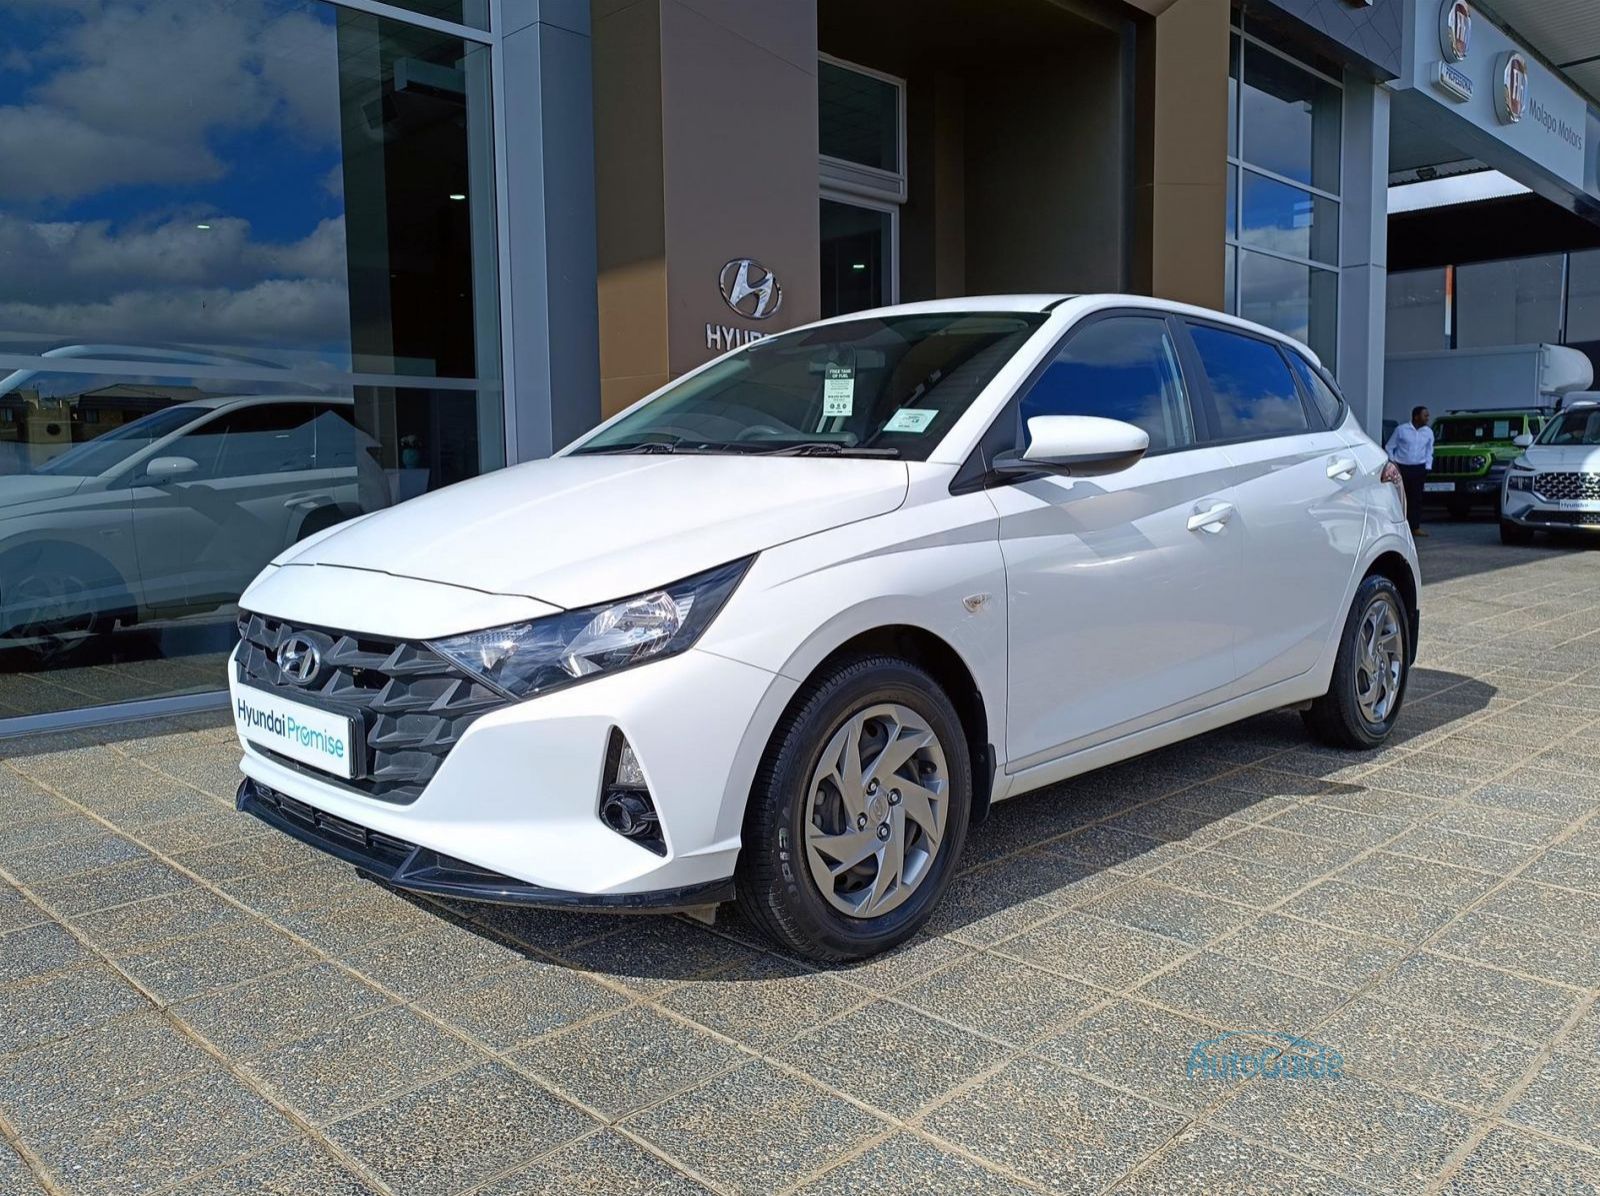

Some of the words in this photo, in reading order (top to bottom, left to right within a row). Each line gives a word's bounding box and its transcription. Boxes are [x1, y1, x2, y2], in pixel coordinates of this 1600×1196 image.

[1529, 98, 1557, 133] Molapo
[1558, 119, 1582, 151] Motors
[237, 697, 286, 737] Hyundai
[287, 716, 344, 758] Promise
